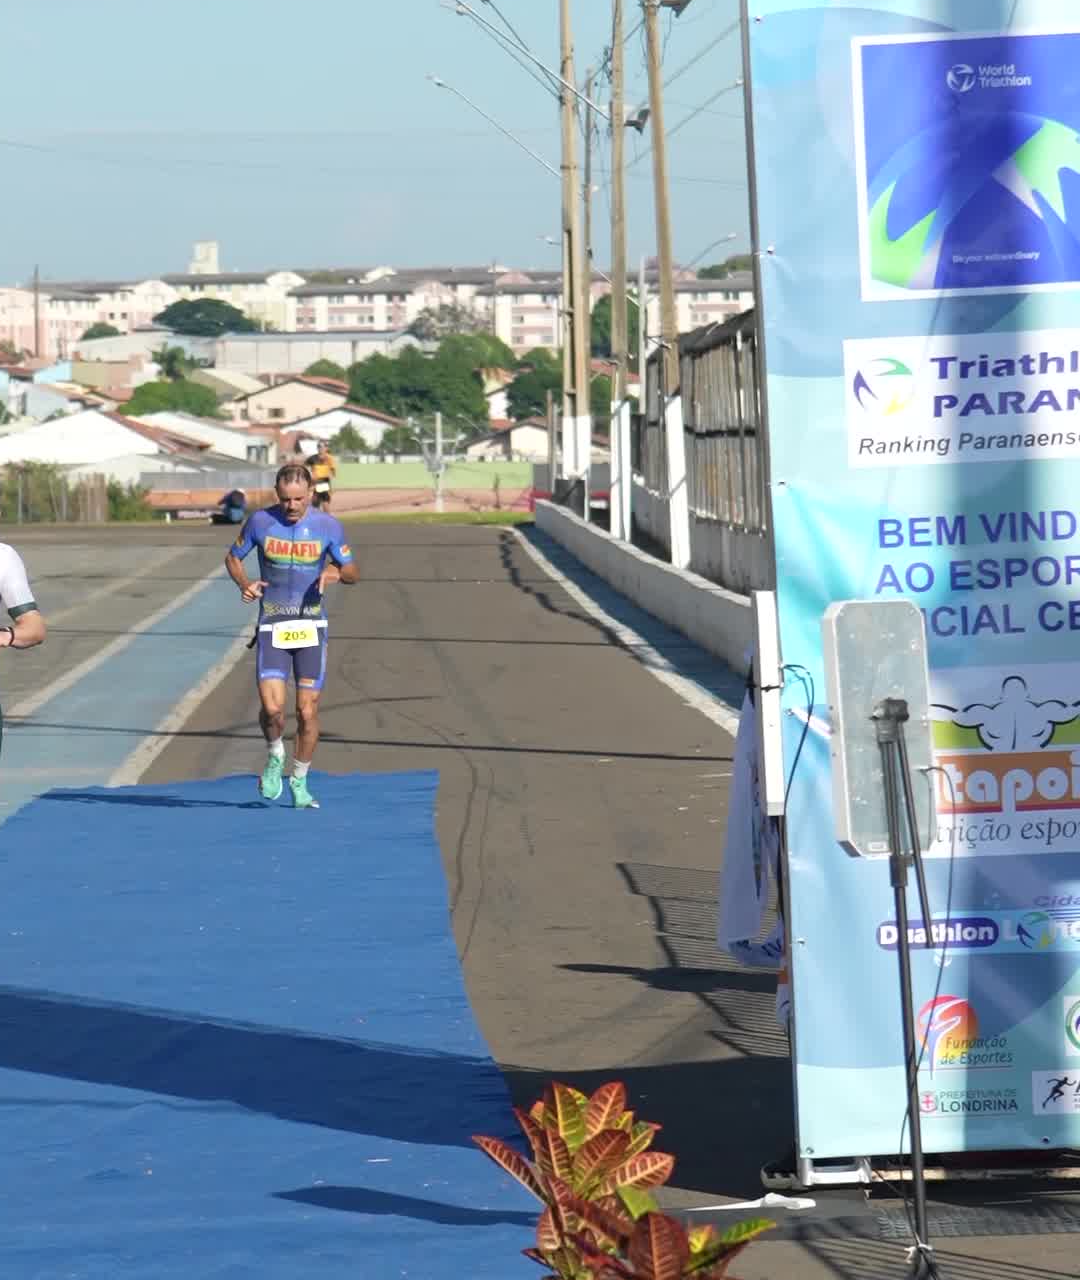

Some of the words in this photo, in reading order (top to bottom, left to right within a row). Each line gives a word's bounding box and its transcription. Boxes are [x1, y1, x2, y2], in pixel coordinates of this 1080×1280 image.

[978, 64, 1015, 76] World
[978, 75, 1032, 88] Triathlon
[930, 350, 1079, 380] Triathl
[858, 438, 951, 456] Ranking
[958, 431, 1080, 452] Paranaens
[878, 515, 967, 549] BEM
[978, 510, 1079, 543] VIND
[266, 538, 320, 558] AMAFIL
[875, 562, 935, 594] AO
[283, 630, 307, 641] 205
[945, 1034, 1007, 1050] Fundação
[940, 1052, 957, 1065] de
[960, 1051, 1013, 1066] Esportes
[941, 1099, 1019, 1113] LONDRINA
